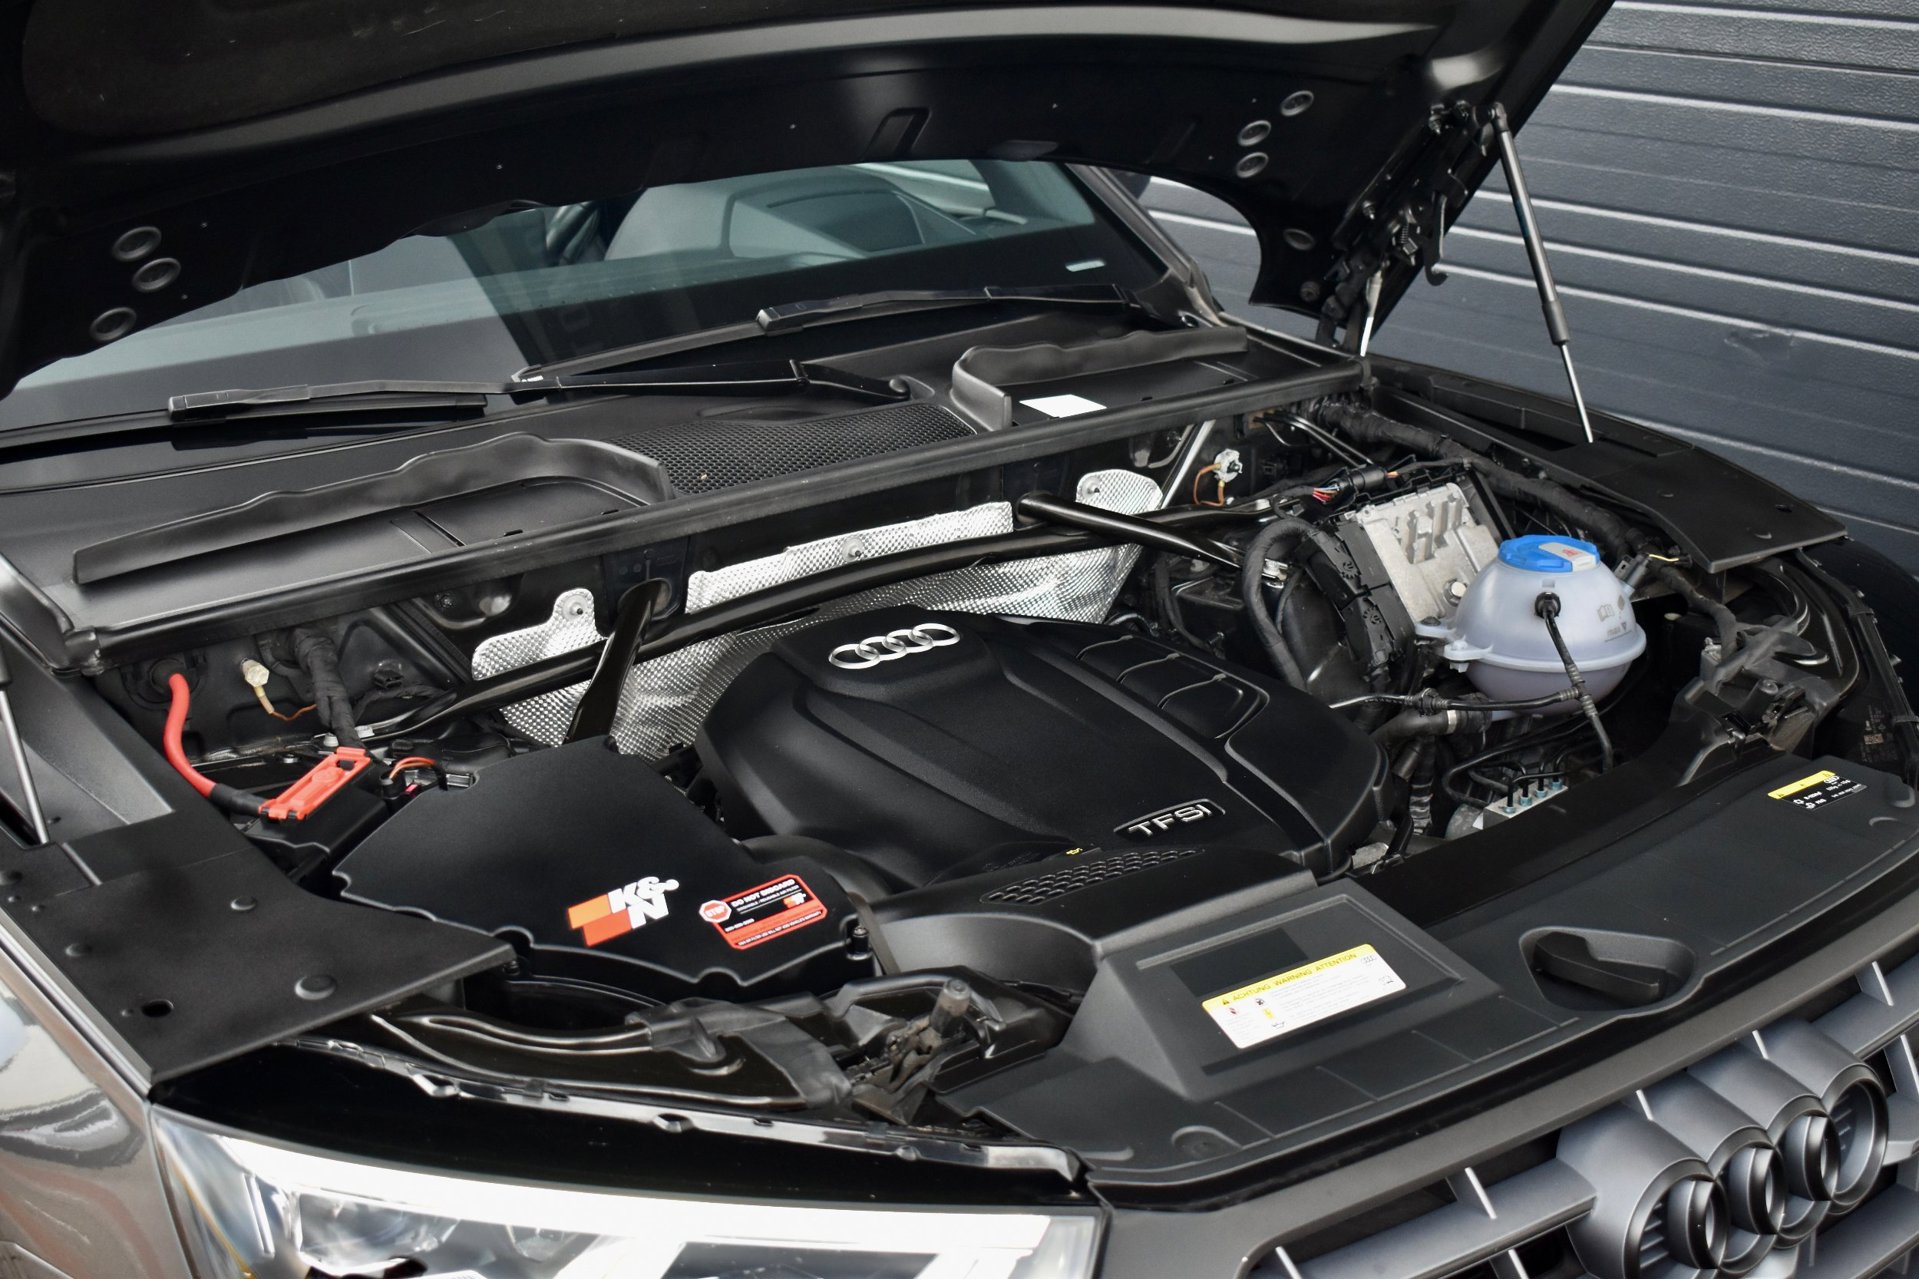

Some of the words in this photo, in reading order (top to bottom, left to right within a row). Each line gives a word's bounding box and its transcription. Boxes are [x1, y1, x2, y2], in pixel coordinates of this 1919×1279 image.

[1128, 804, 1212, 835] TFSI
[731, 898, 745, 909] DO
[743, 892, 761, 904] NOT
[1233, 983, 1271, 1001] ACHTUNG
[1275, 969, 1312, 986] WARNING
[1315, 953, 1357, 972] ATTENTION
